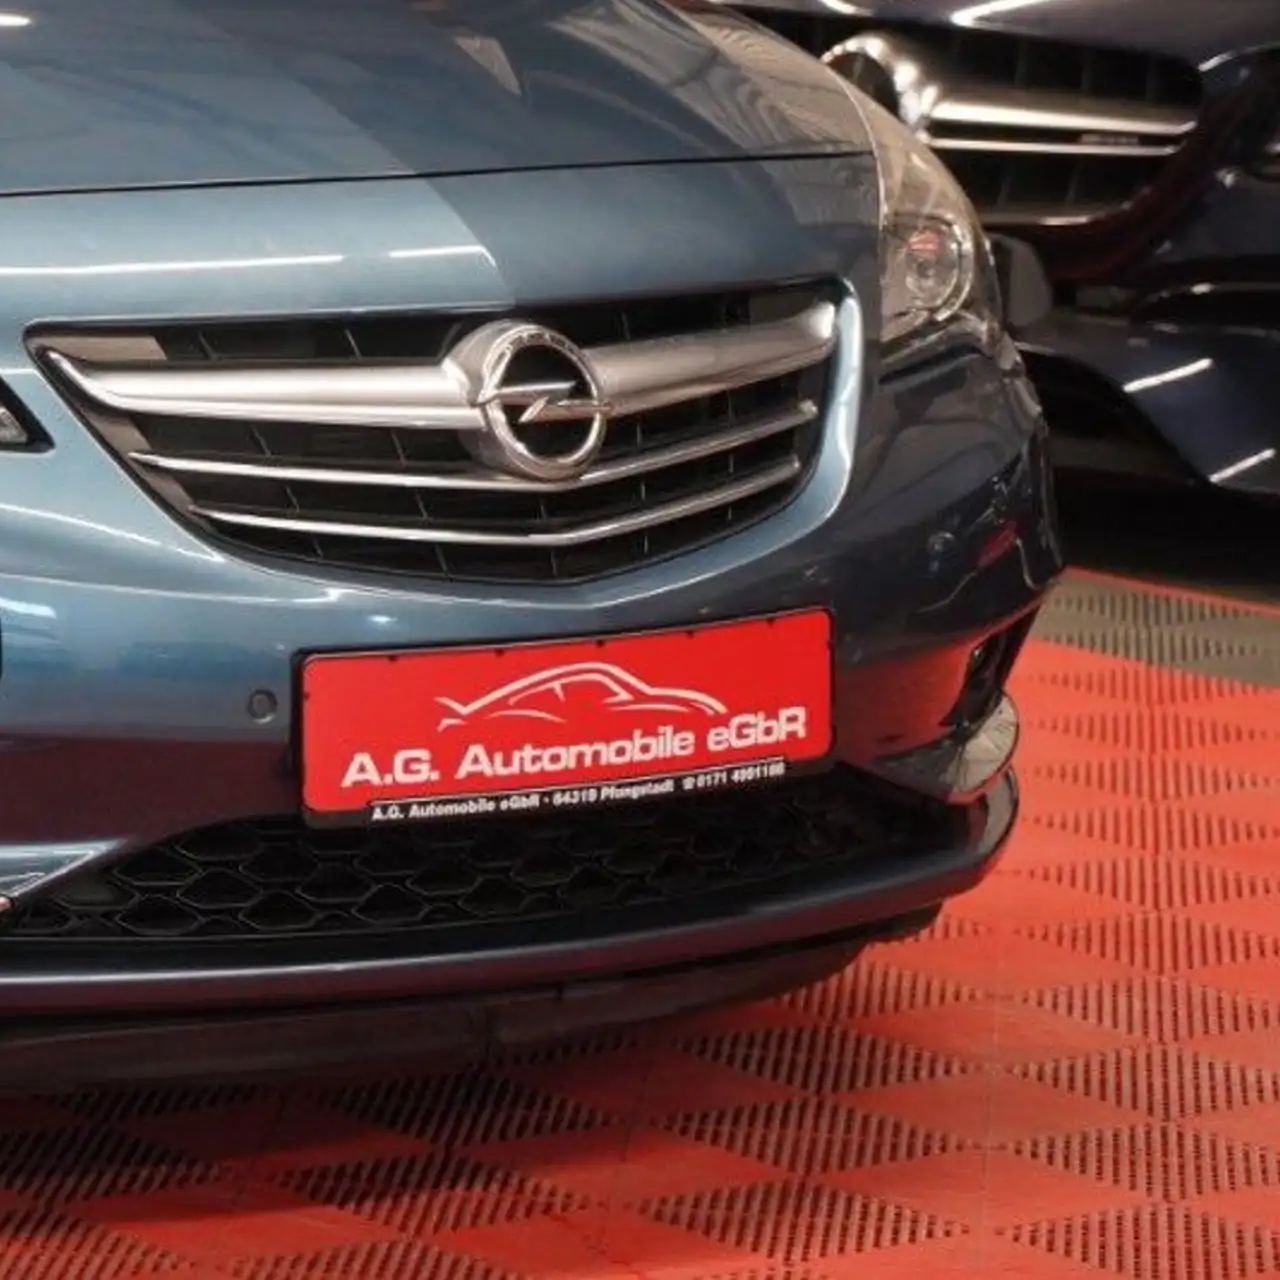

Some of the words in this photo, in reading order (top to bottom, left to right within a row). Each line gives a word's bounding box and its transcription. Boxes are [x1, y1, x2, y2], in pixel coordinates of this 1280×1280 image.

[341, 749, 440, 788] A.G.
[455, 722, 696, 780] Automobile
[707, 706, 807, 753] eGbR
[409, 797, 496, 819] Automobile
